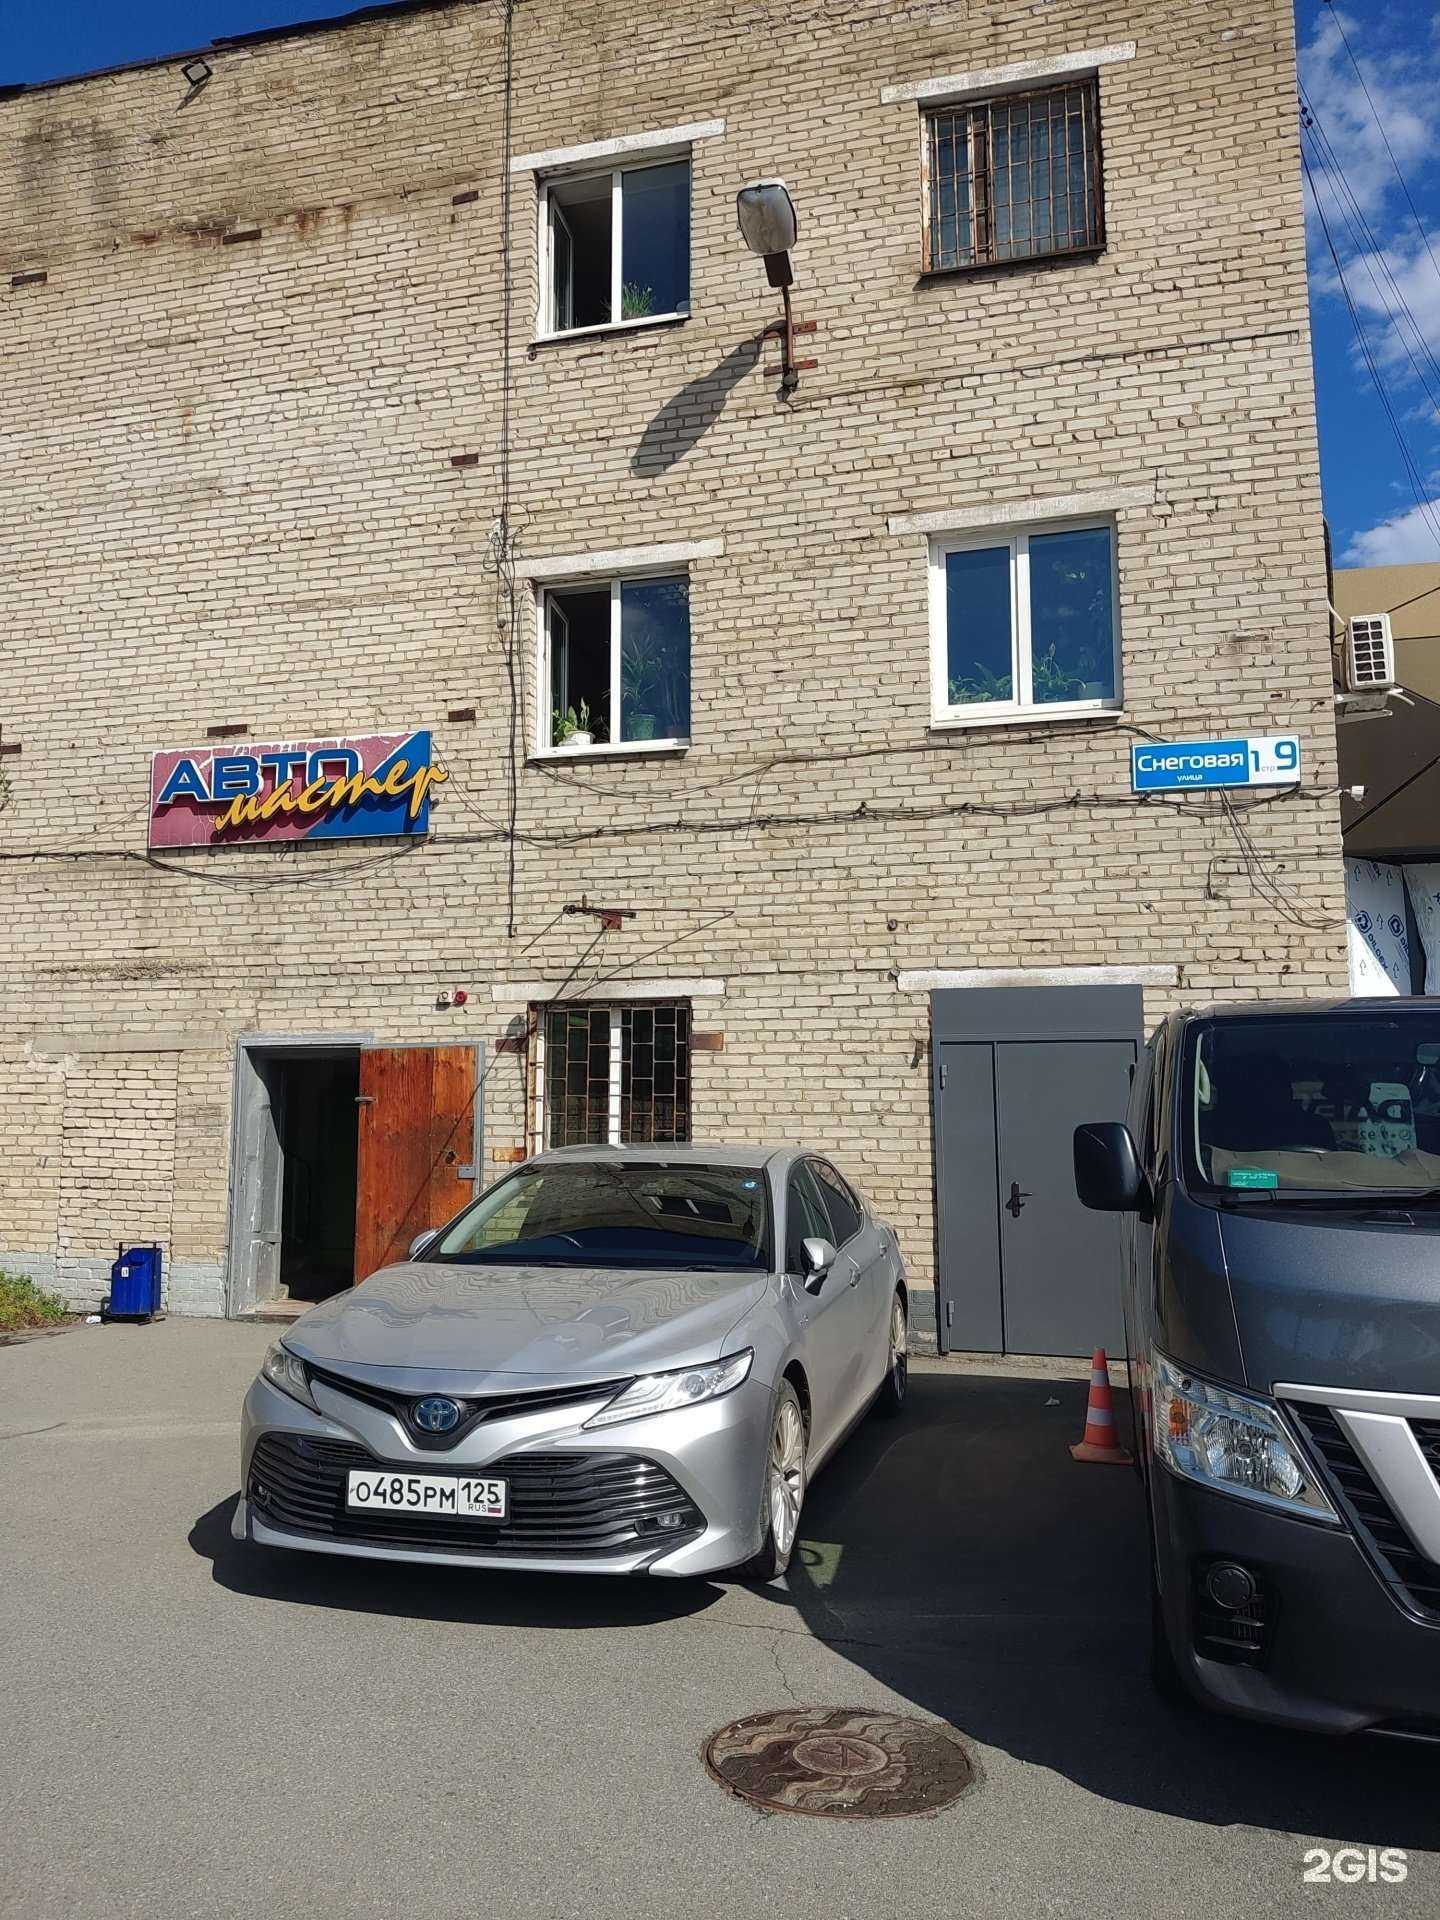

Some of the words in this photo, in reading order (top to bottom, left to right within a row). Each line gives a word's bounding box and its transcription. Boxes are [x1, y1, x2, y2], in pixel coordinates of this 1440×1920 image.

[1137, 752, 1244, 772] Снеговая
[1250, 750, 1260, 772] 1
[1274, 740, 1297, 770] 9
[156, 748, 361, 804] АВТО
[1176, 774, 1203, 783] улица
[214, 759, 449, 832] мастер
[468, 1503, 487, 1513] RUS
